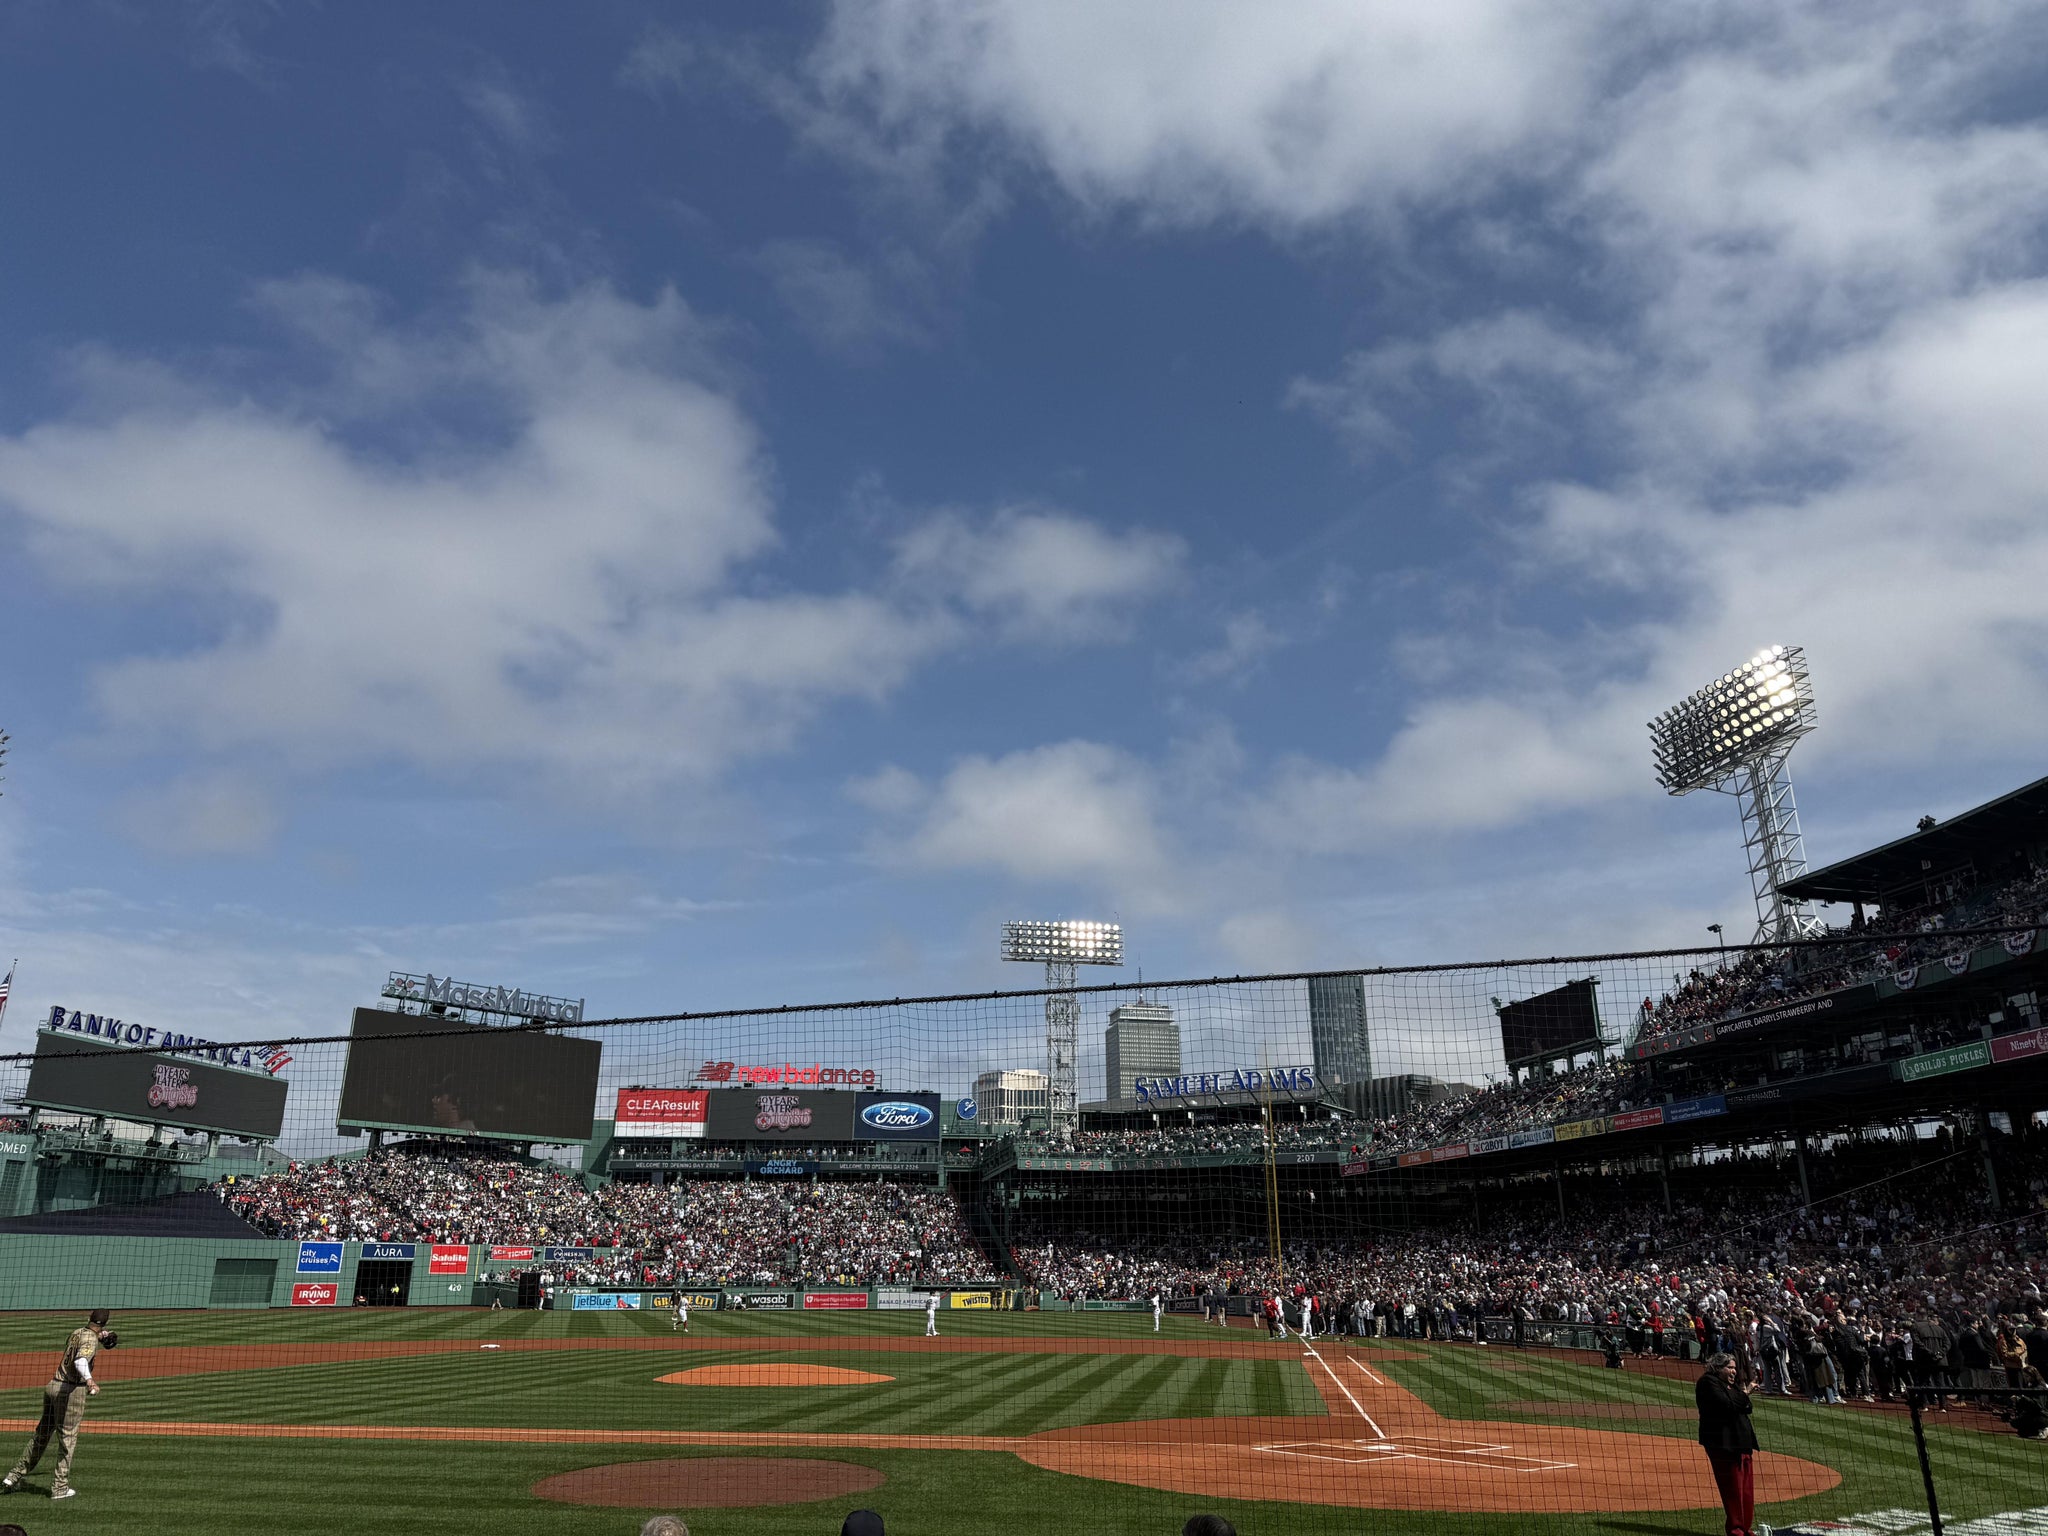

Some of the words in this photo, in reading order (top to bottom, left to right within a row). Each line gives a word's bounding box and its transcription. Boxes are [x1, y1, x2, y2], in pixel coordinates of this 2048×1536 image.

[423, 973, 585, 1023] MassMutual
[1776, 1003, 1816, 1020] STRAWBERRY
[1817, 999, 1833, 1010] AND
[49, 1006, 121, 1038] BANK
[128, 1024, 156, 1046] OF
[162, 1032, 251, 1067] AMERICA
[2010, 1038, 2036, 1051] Ninety
[1914, 1057, 1946, 1073] GRILLO'S
[1950, 1049, 1984, 1066] PICKLES
[164, 1067, 190, 1080] YEARS
[737, 1065, 781, 1083] new
[784, 1062, 875, 1084] balance
[157, 1076, 181, 1089] LATER
[1135, 1074, 1226, 1104] SAMUEL
[1231, 1067, 1315, 1094] ADAMS
[626, 1100, 700, 1110] CLEAResult
[768, 1097, 799, 1105] YEARS
[875, 1106, 919, 1125] Ford
[1297, 1154, 1315, 1162] 2:07
[432, 1254, 467, 1262] Safelite
[508, 1249, 533, 1259] TICKET
[448, 1283, 462, 1292] 420
[298, 1290, 330, 1299] IRVING
[750, 1294, 788, 1304] wasabi
[576, 1295, 612, 1307] jetBlue
[962, 1297, 989, 1307] TWISTED
